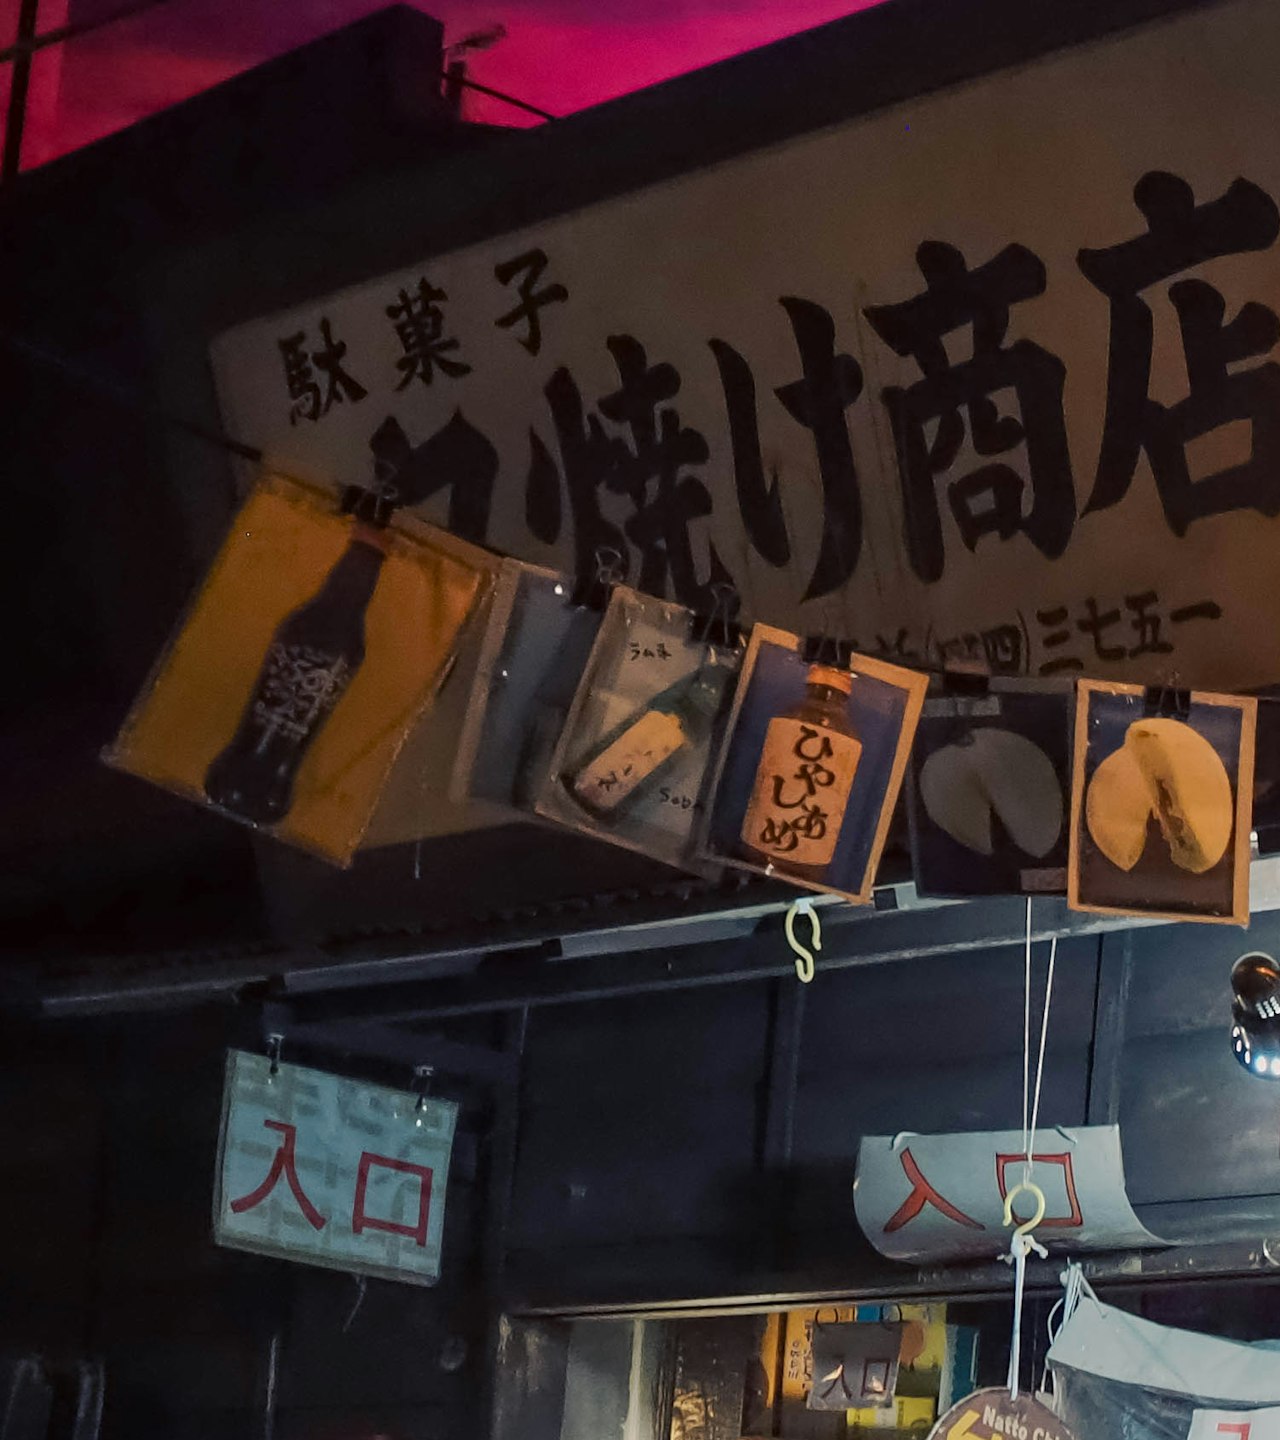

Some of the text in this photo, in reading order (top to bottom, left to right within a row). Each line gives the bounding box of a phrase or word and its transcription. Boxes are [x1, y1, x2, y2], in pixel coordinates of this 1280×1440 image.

[277, 247, 569, 427] 駄菓子
[231, 1118, 434, 1247] 入口
[882, 1148, 1083, 1232] 入口
[820, 1357, 891, 1401] 入口
